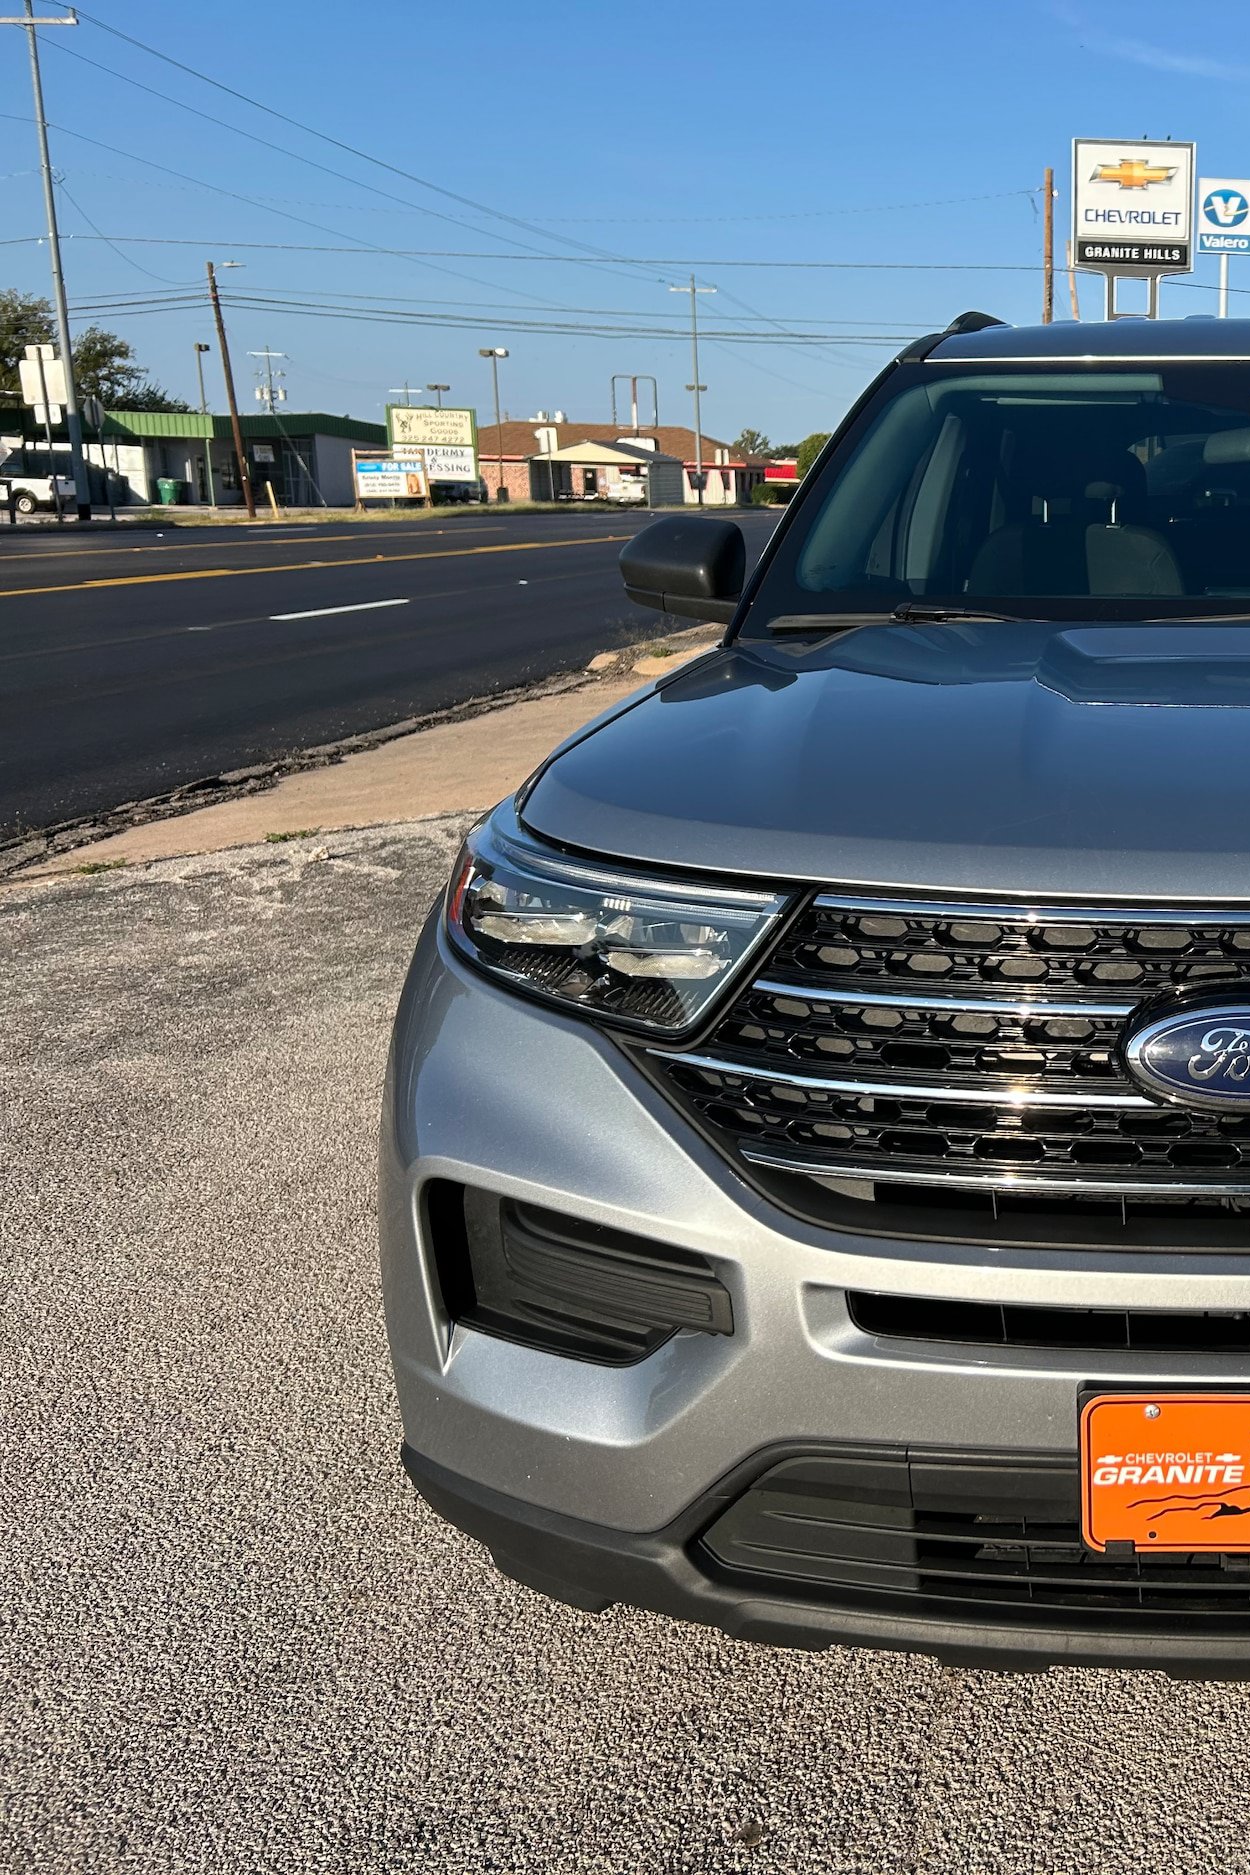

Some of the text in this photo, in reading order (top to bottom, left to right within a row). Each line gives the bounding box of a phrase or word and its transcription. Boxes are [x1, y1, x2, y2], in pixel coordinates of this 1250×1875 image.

[1084, 208, 1182, 226] CHEVROLET
[1202, 235, 1249, 249] Valero
[1084, 246, 1181, 261] GRANITE HILLS
[423, 419, 464, 428] SPORTING
[430, 427, 459, 435] GOODS
[382, 462, 399, 471] FOR
[400, 462, 422, 471] SALE
[1125, 1452, 1213, 1464] CHEVROLET
[1093, 1464, 1246, 1485] GRANITE
